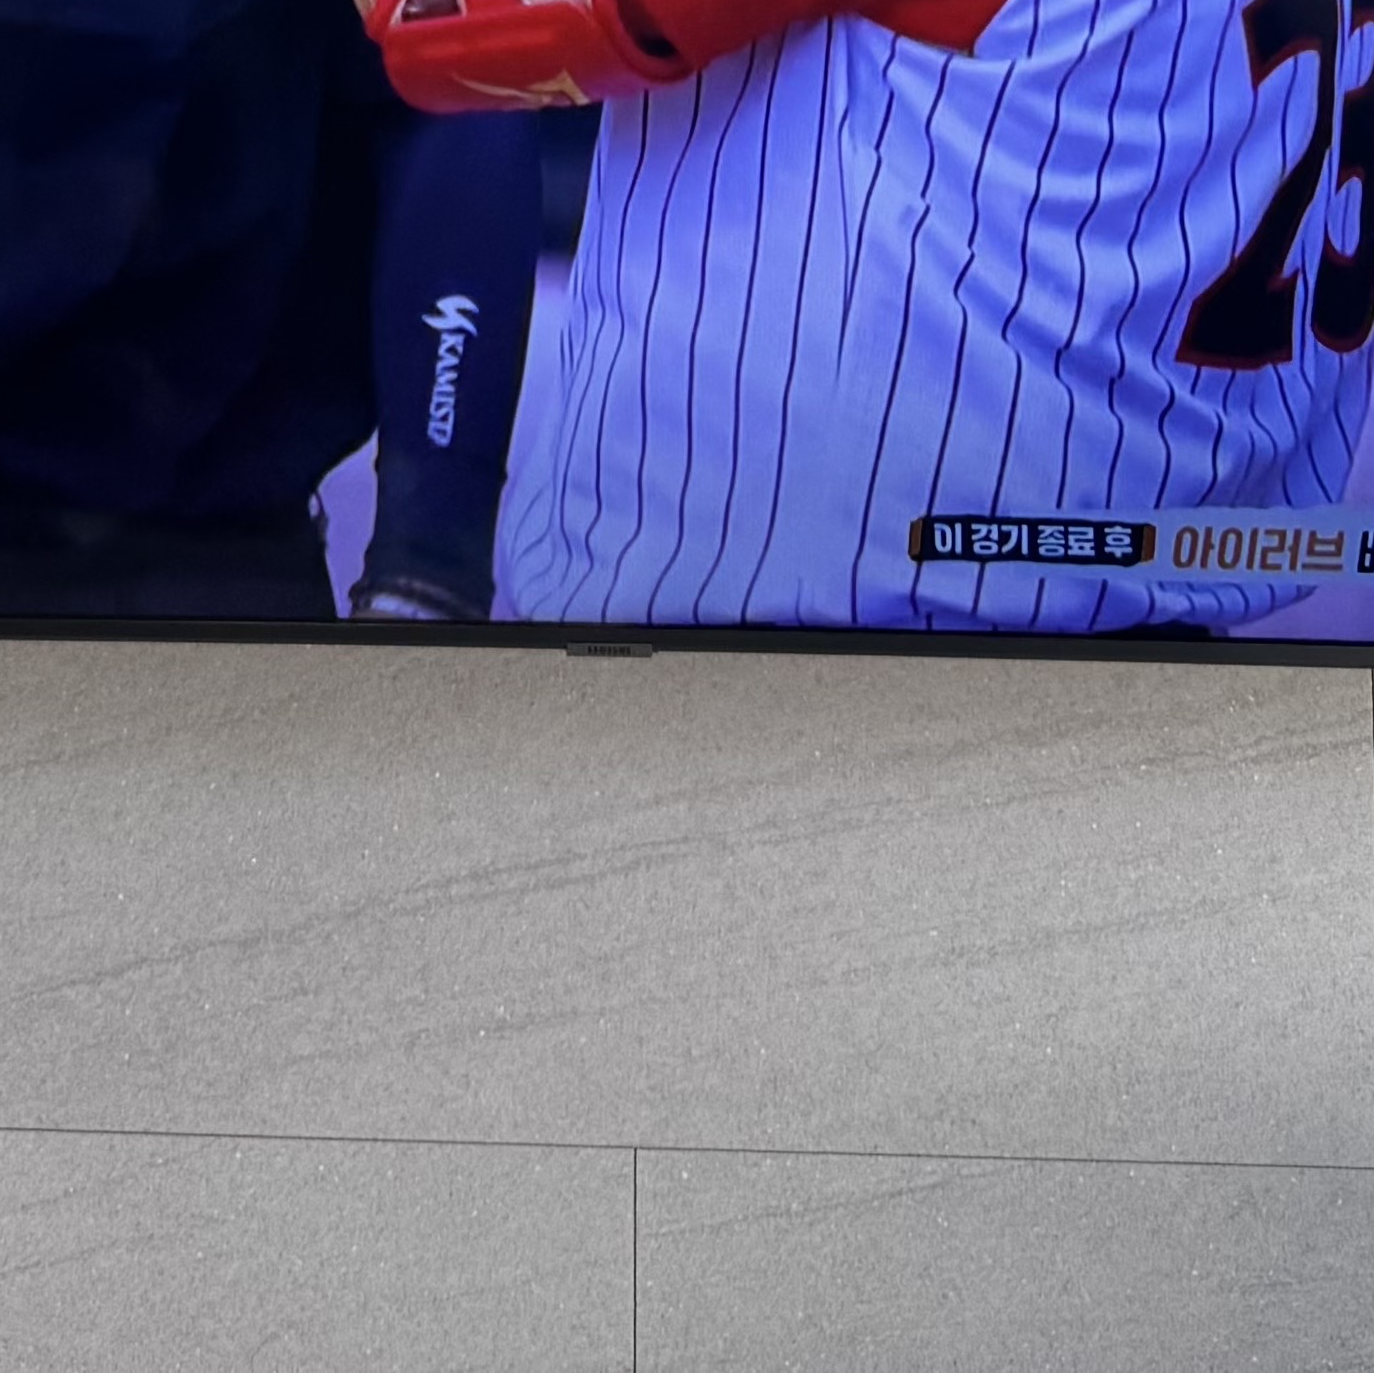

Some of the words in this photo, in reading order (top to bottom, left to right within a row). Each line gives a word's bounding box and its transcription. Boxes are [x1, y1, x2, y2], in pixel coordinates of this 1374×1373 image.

[934, 522, 962, 555] 이
[971, 523, 1028, 555] 경기
[1037, 525, 1095, 557] 종료
[1104, 525, 1133, 558] 후
[1172, 526, 1344, 571] 아이러브
